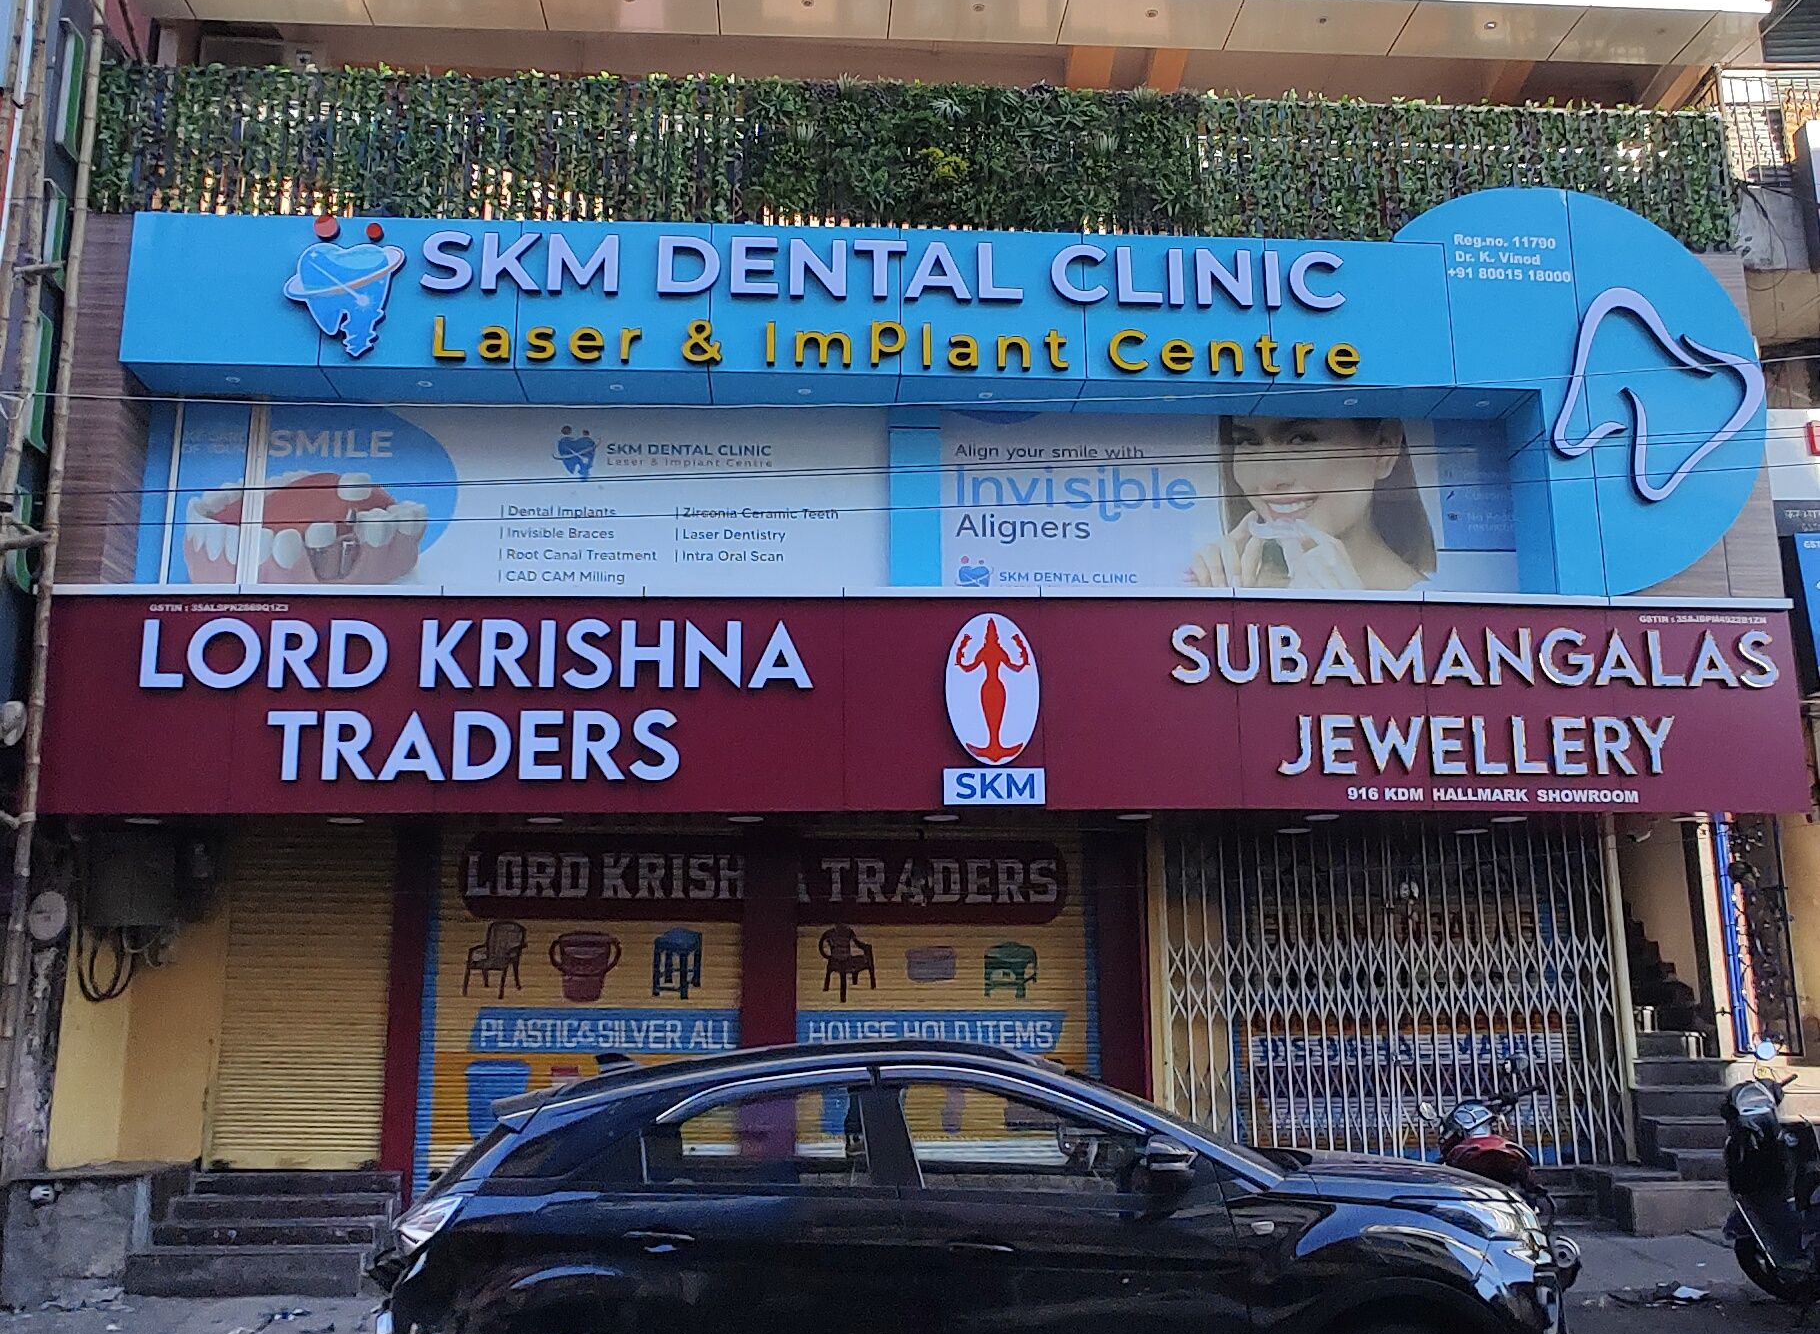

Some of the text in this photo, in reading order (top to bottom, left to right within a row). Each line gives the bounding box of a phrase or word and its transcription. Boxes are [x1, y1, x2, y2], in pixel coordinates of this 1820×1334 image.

[1455, 251, 1541, 265] Dr. K. Vinod
[419, 230, 1346, 311] SKM DENTAL CLINIC
[1447, 267, 1571, 282] +91 80015 18000
[432, 316, 642, 362] Laser
[682, 319, 723, 363] &
[1108, 327, 1361, 375] Centre
[269, 430, 394, 457] SMILE
[607, 444, 772, 456] SKM DENTAL CLINIC
[955, 443, 1144, 460] Align your smile with
[607, 458, 643, 466] Laser
[664, 458, 720, 468] Implant
[726, 459, 773, 467] Centre
[956, 464, 1197, 522] Invisible
[508, 505, 617, 518] Dental Implants
[683, 507, 838, 519] Zirconia Ceramic Teeth
[507, 527, 614, 539] Invisible Braces
[683, 528, 786, 543] Laser Dentistry
[955, 513, 1091, 545] Aligners
[506, 548, 657, 561] Root Canal Treatment
[682, 550, 784, 562] Intra Oral Scan
[506, 570, 625, 585] CAD CAM Milling
[1000, 572, 1138, 584] SKM DENTAL CLINIC
[149, 604, 182, 612] GSTIN
[1639, 615, 1669, 623] GSTIN
[138, 619, 813, 690] LORD KRISHNA
[1170, 624, 1780, 688] SUBAMANGALAS
[267, 709, 681, 782] TRADERS
[1278, 713, 1675, 775] JEWELLERY
[955, 772, 1036, 800] SKM
[1347, 787, 1639, 803] 916 KDM HALLMARK SHOWROOM
[465, 851, 589, 898] LORD
[821, 857, 1058, 904] TRADERS
[689, 1020, 737, 1050] ALL
[808, 1020, 896, 1043] HOUSE
[977, 1021, 1053, 1049] ITEMS
